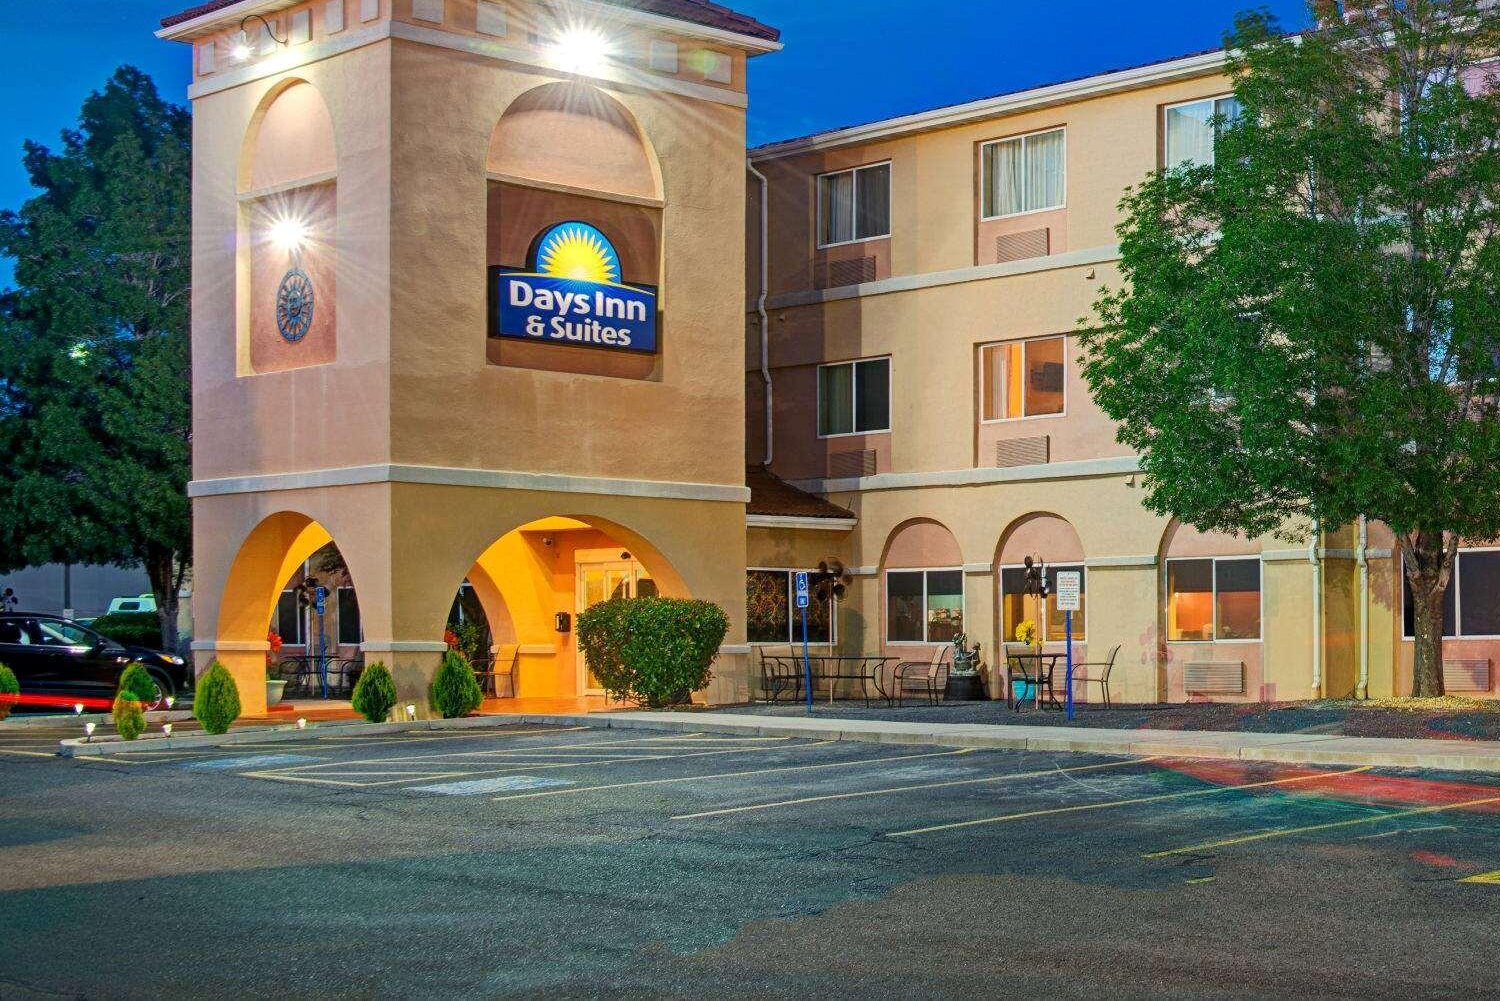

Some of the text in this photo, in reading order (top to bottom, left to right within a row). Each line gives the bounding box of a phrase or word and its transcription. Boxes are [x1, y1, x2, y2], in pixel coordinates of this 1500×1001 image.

[510, 280, 646, 322] Days Inn
[526, 315, 632, 346] & Suites
